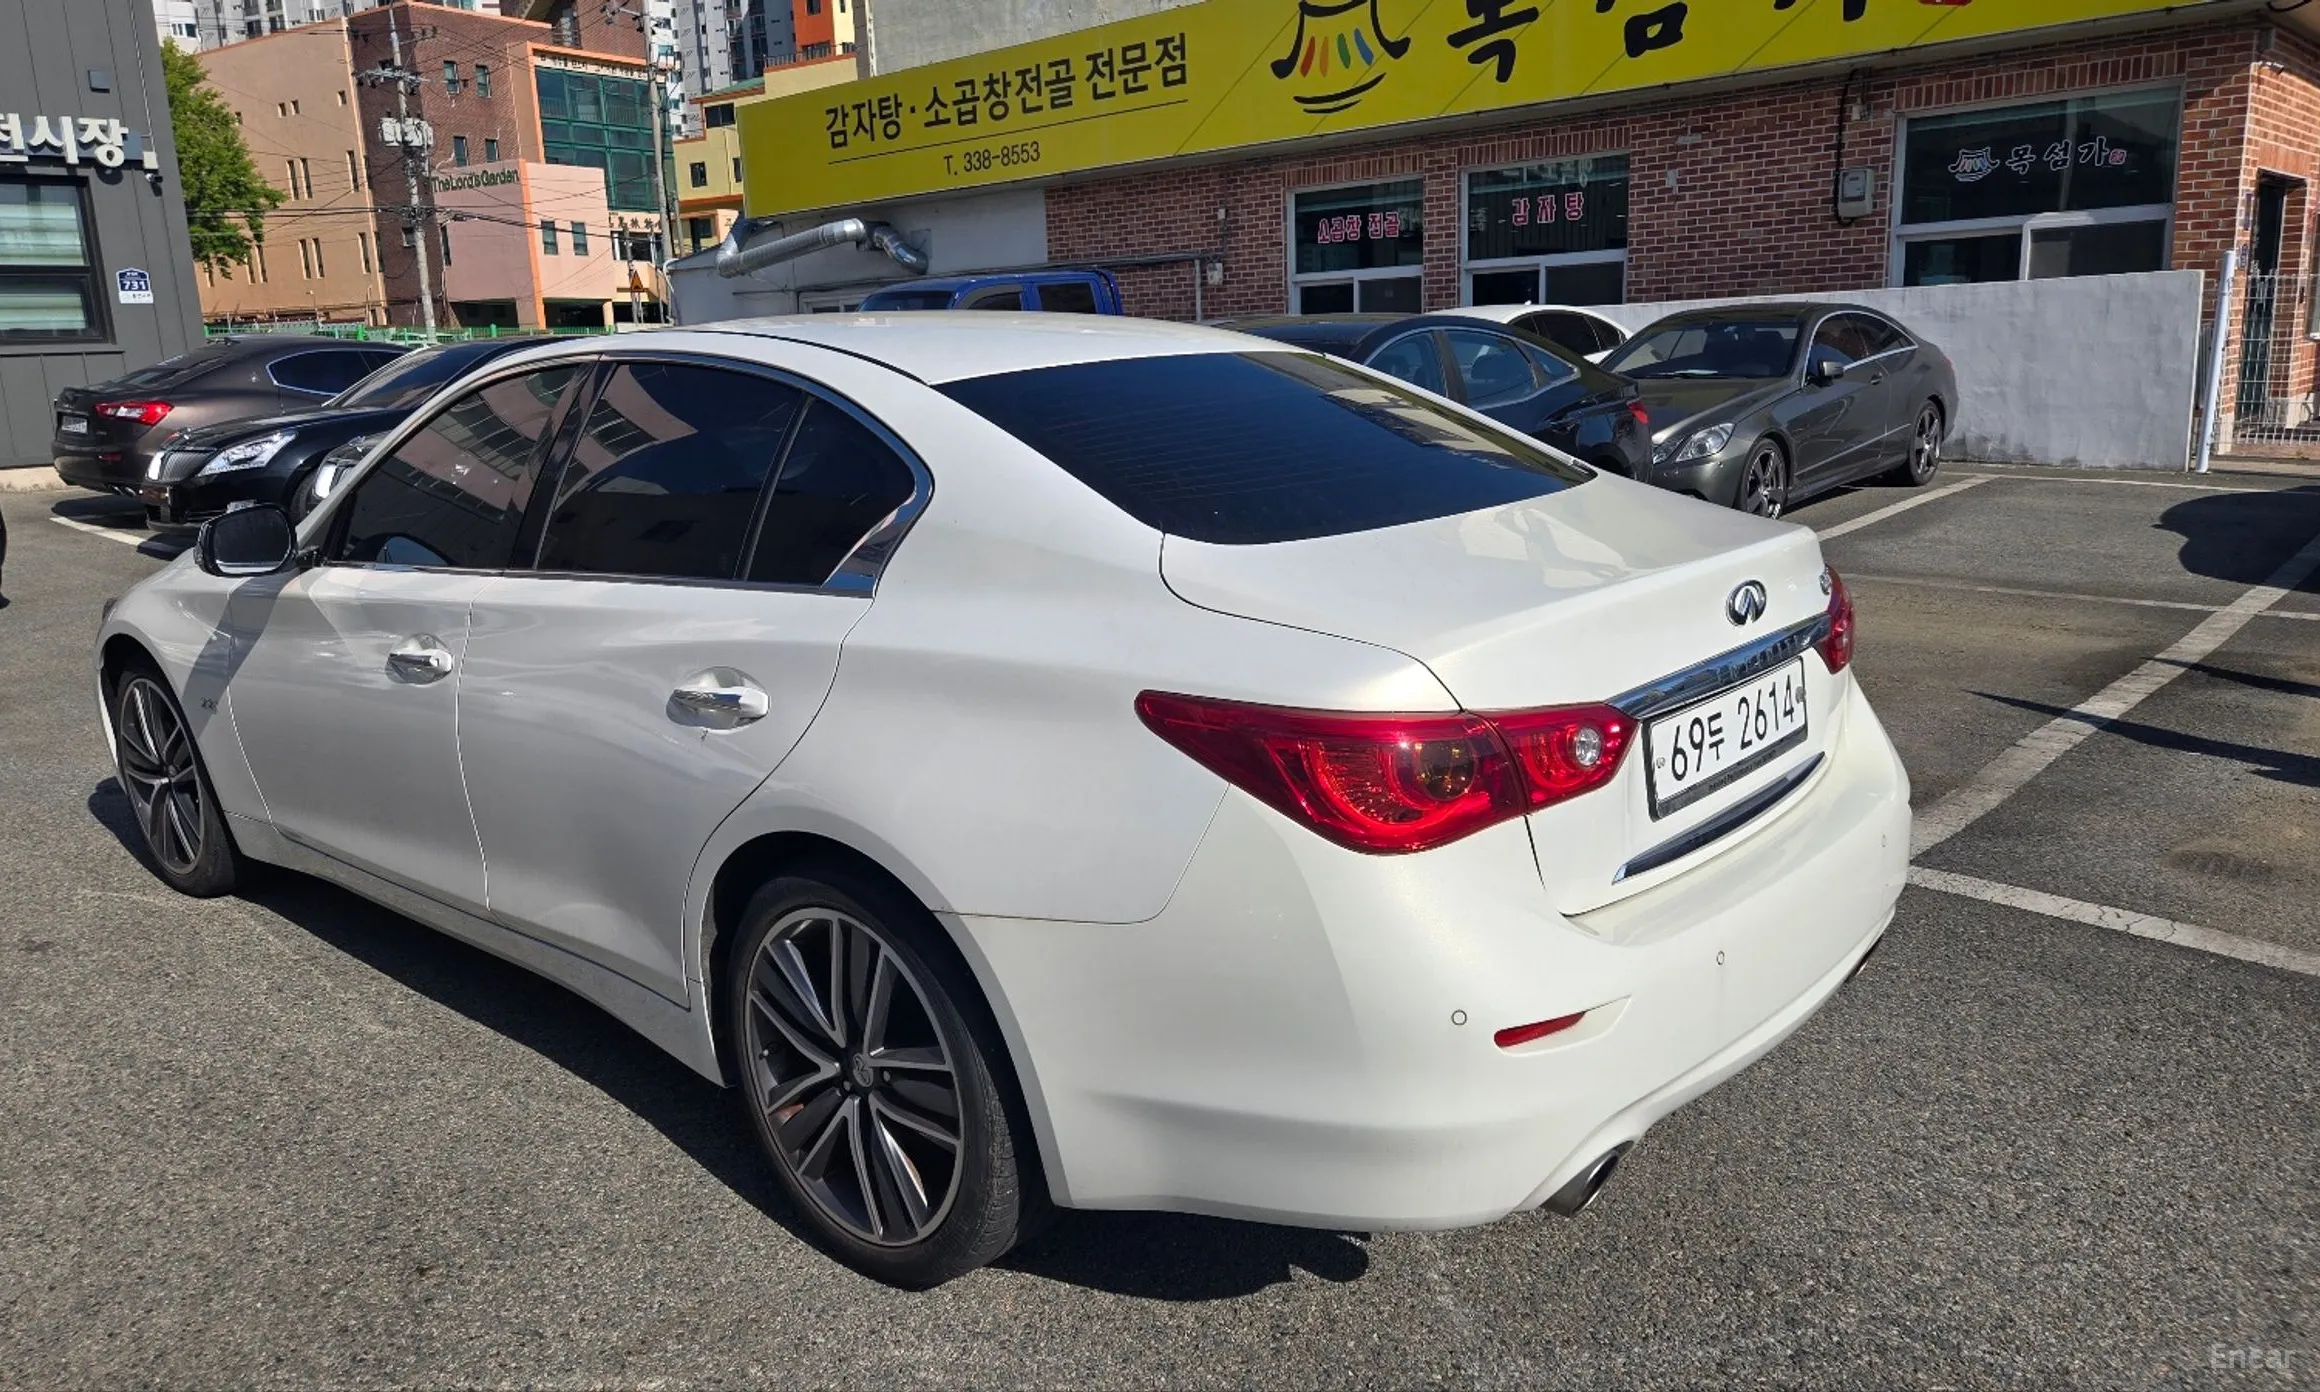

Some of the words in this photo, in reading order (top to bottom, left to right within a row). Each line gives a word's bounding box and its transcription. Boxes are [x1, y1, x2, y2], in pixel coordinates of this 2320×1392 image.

[1086, 32, 1188, 101] 전문점
[943, 154, 958, 176] T.
[963, 140, 1041, 173] 338-8553
[431, 175, 451, 192] The
[481, 168, 519, 186] Garden
[1512, 191, 1585, 227] 감자탕
[1317, 214, 1362, 244] 소곱창
[1367, 211, 1400, 240] 전골
[122, 280, 147, 290] 731
[1671, 711, 1724, 781] 69두
[1737, 674, 1795, 750] 2614
